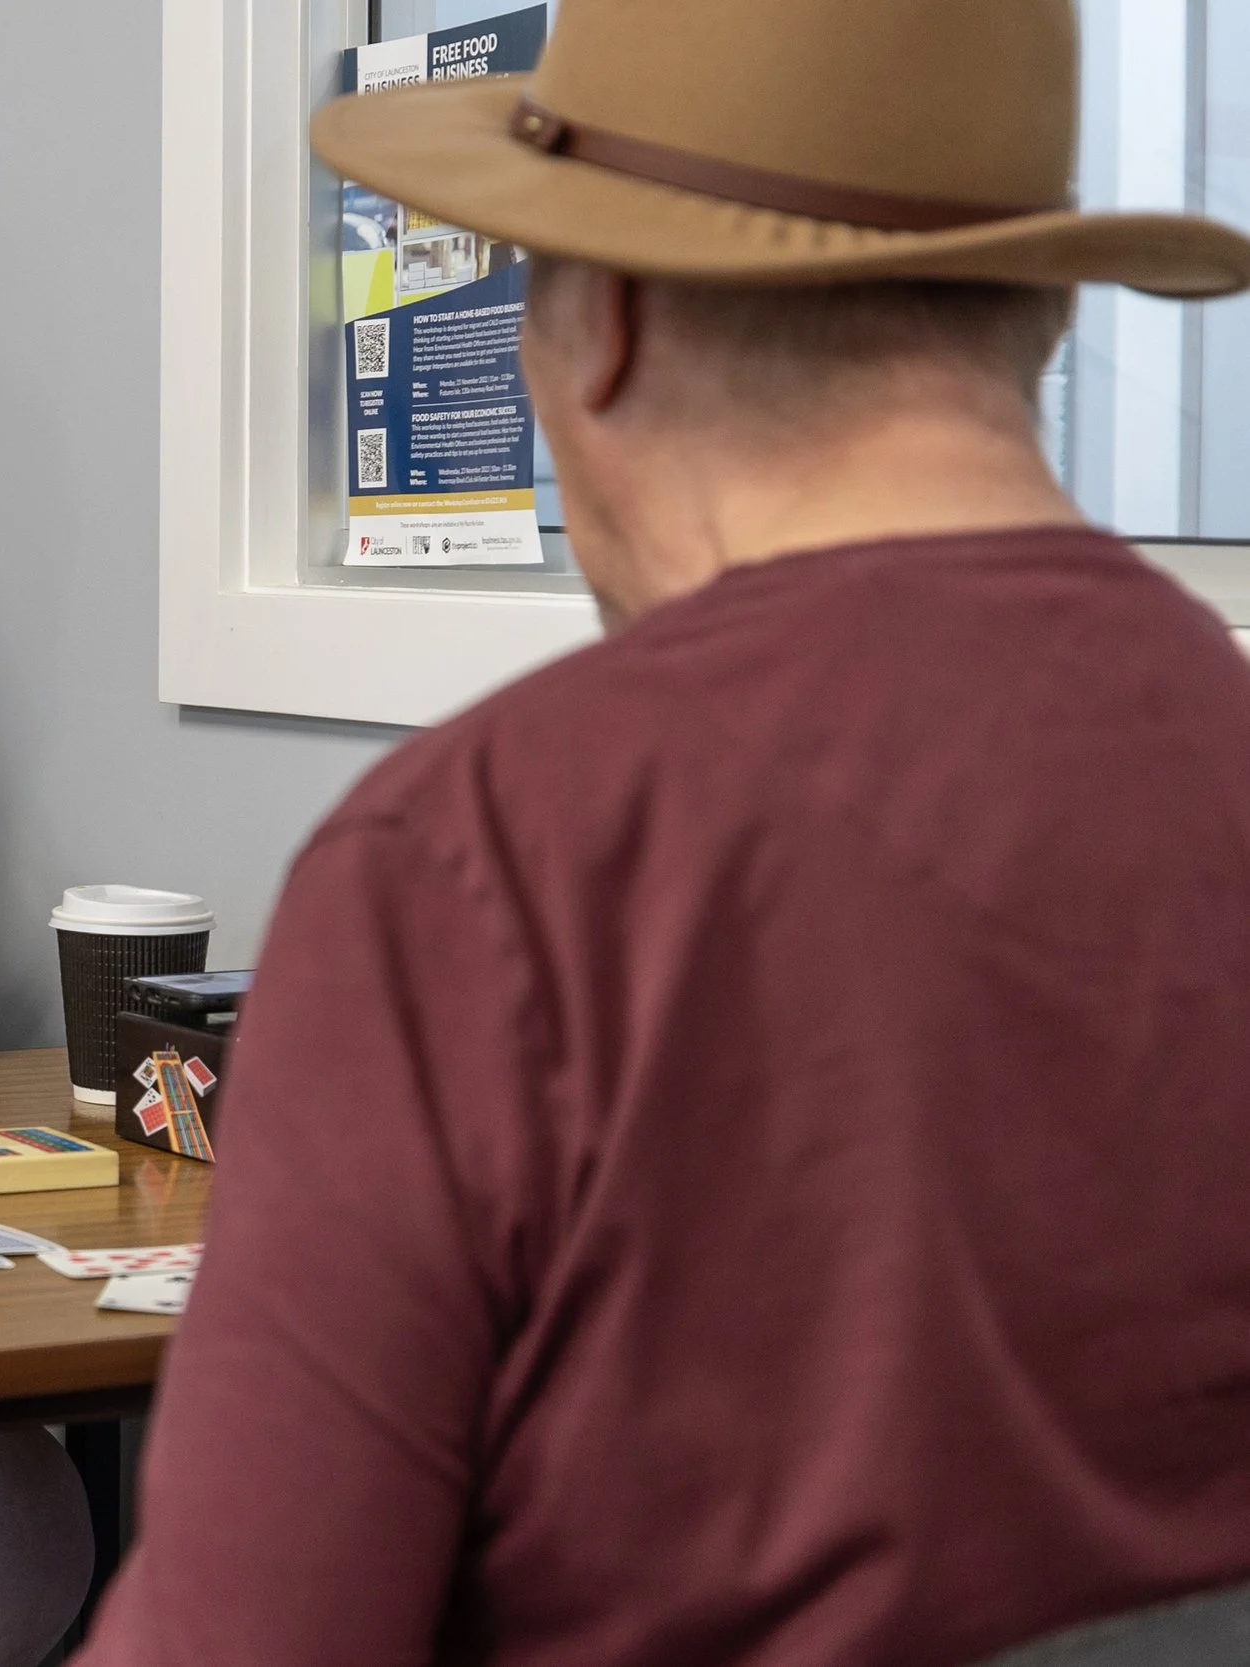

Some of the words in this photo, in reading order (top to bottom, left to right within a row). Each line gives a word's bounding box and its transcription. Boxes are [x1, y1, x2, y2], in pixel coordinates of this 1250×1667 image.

[432, 41, 462, 65] FREE
[463, 33, 498, 58] FOOD
[365, 72, 376, 80] CITY
[377, 70, 384, 78] OF
[385, 64, 419, 77] LAUNCESTON
[432, 56, 488, 83] BUSINESS
[364, 75, 420, 96] BUSINESS
[413, 315, 428, 324] HOW
[429, 314, 438, 322] TO
[438, 312, 455, 322] START
[455, 312, 459, 320] A
[460, 307, 490, 319] HOME-BASED
[490, 305, 504, 314] FOOD
[504, 302, 526, 313] BUSINESS
[412, 413, 430, 422] FOOD
[430, 412, 451, 421] SAFETY
[451, 411, 461, 420] FOR
[461, 409, 474, 419] YOUR
[475, 407, 499, 417] ECONOMIC
[499, 405, 517, 415] SUCCESS
[371, 547, 402, 555] LAUNCESTON
